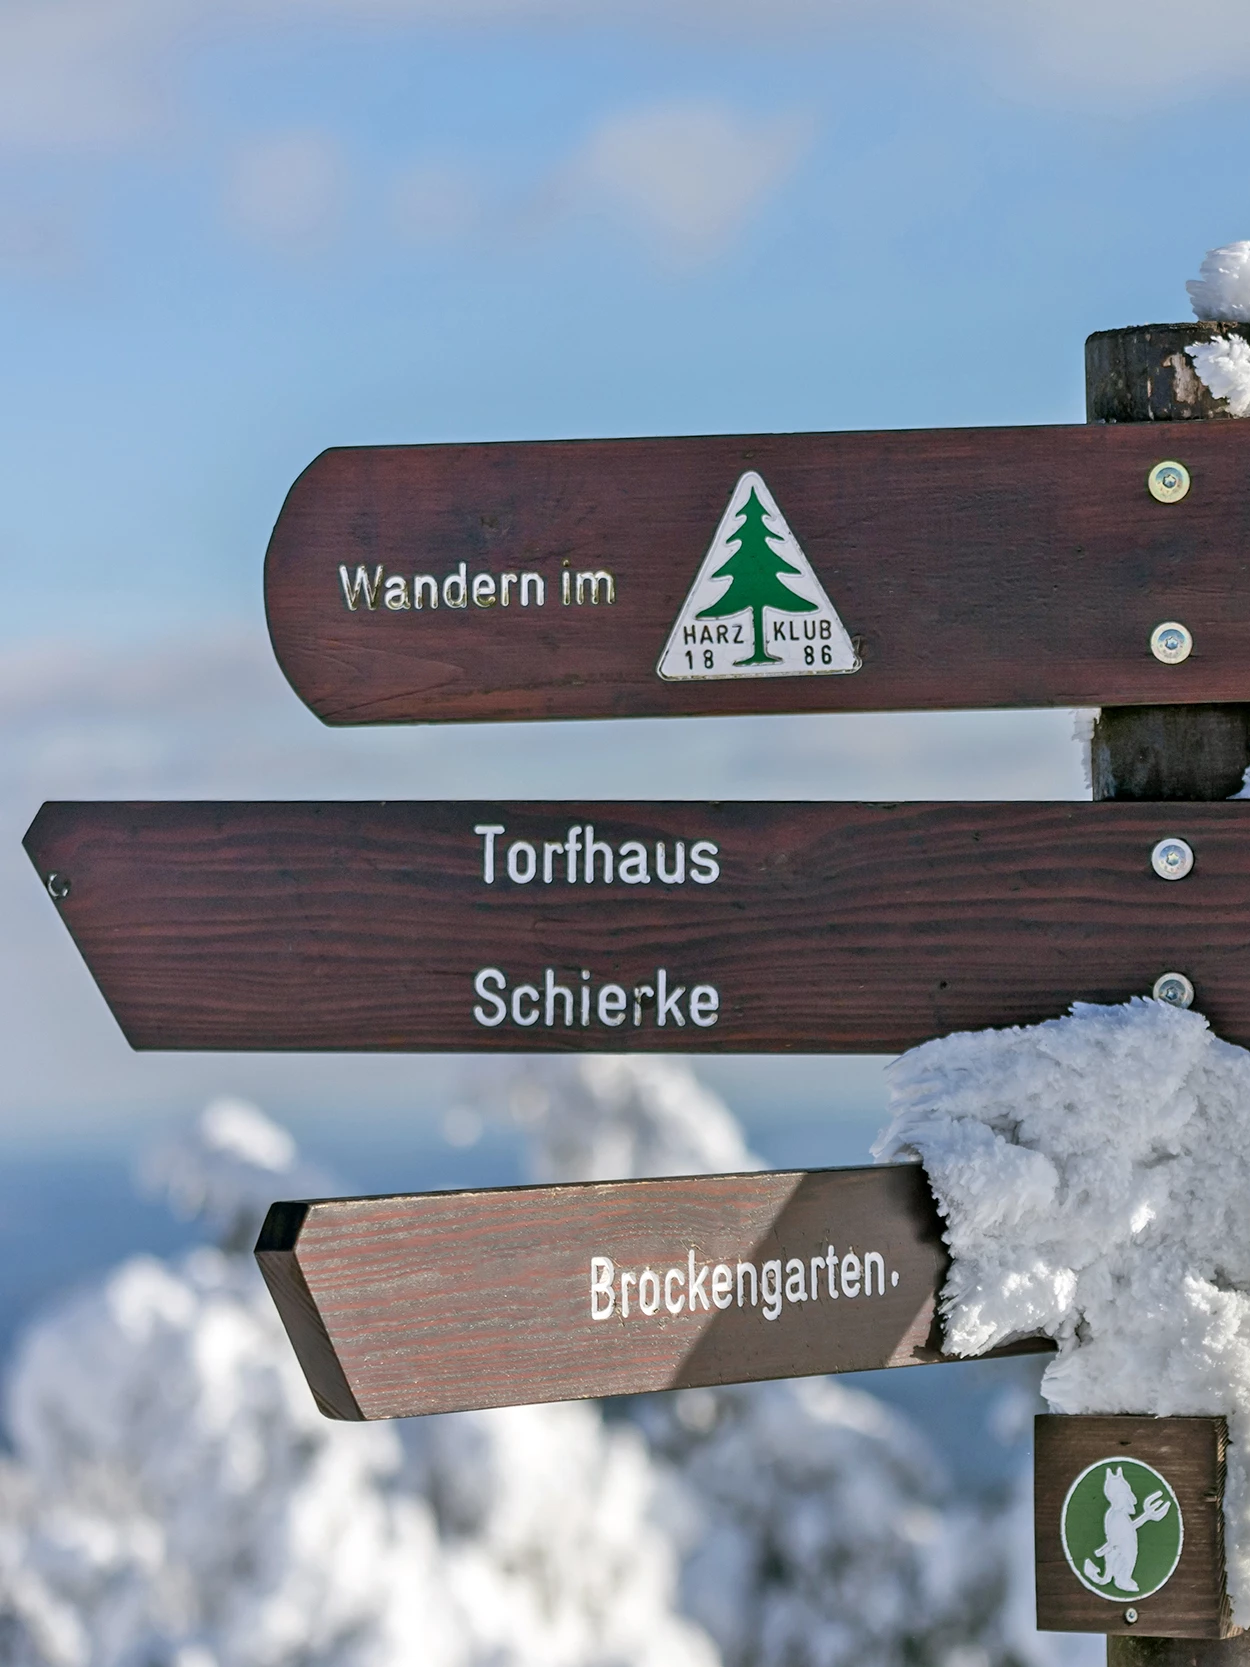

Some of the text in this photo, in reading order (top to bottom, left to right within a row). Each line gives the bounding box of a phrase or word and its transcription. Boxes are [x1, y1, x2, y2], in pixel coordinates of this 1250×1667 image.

[338, 559, 615, 611] Wandern im
[683, 619, 832, 645] HARZ KLUB
[473, 824, 721, 886] Torfhaus
[473, 966, 721, 1028] Schierke
